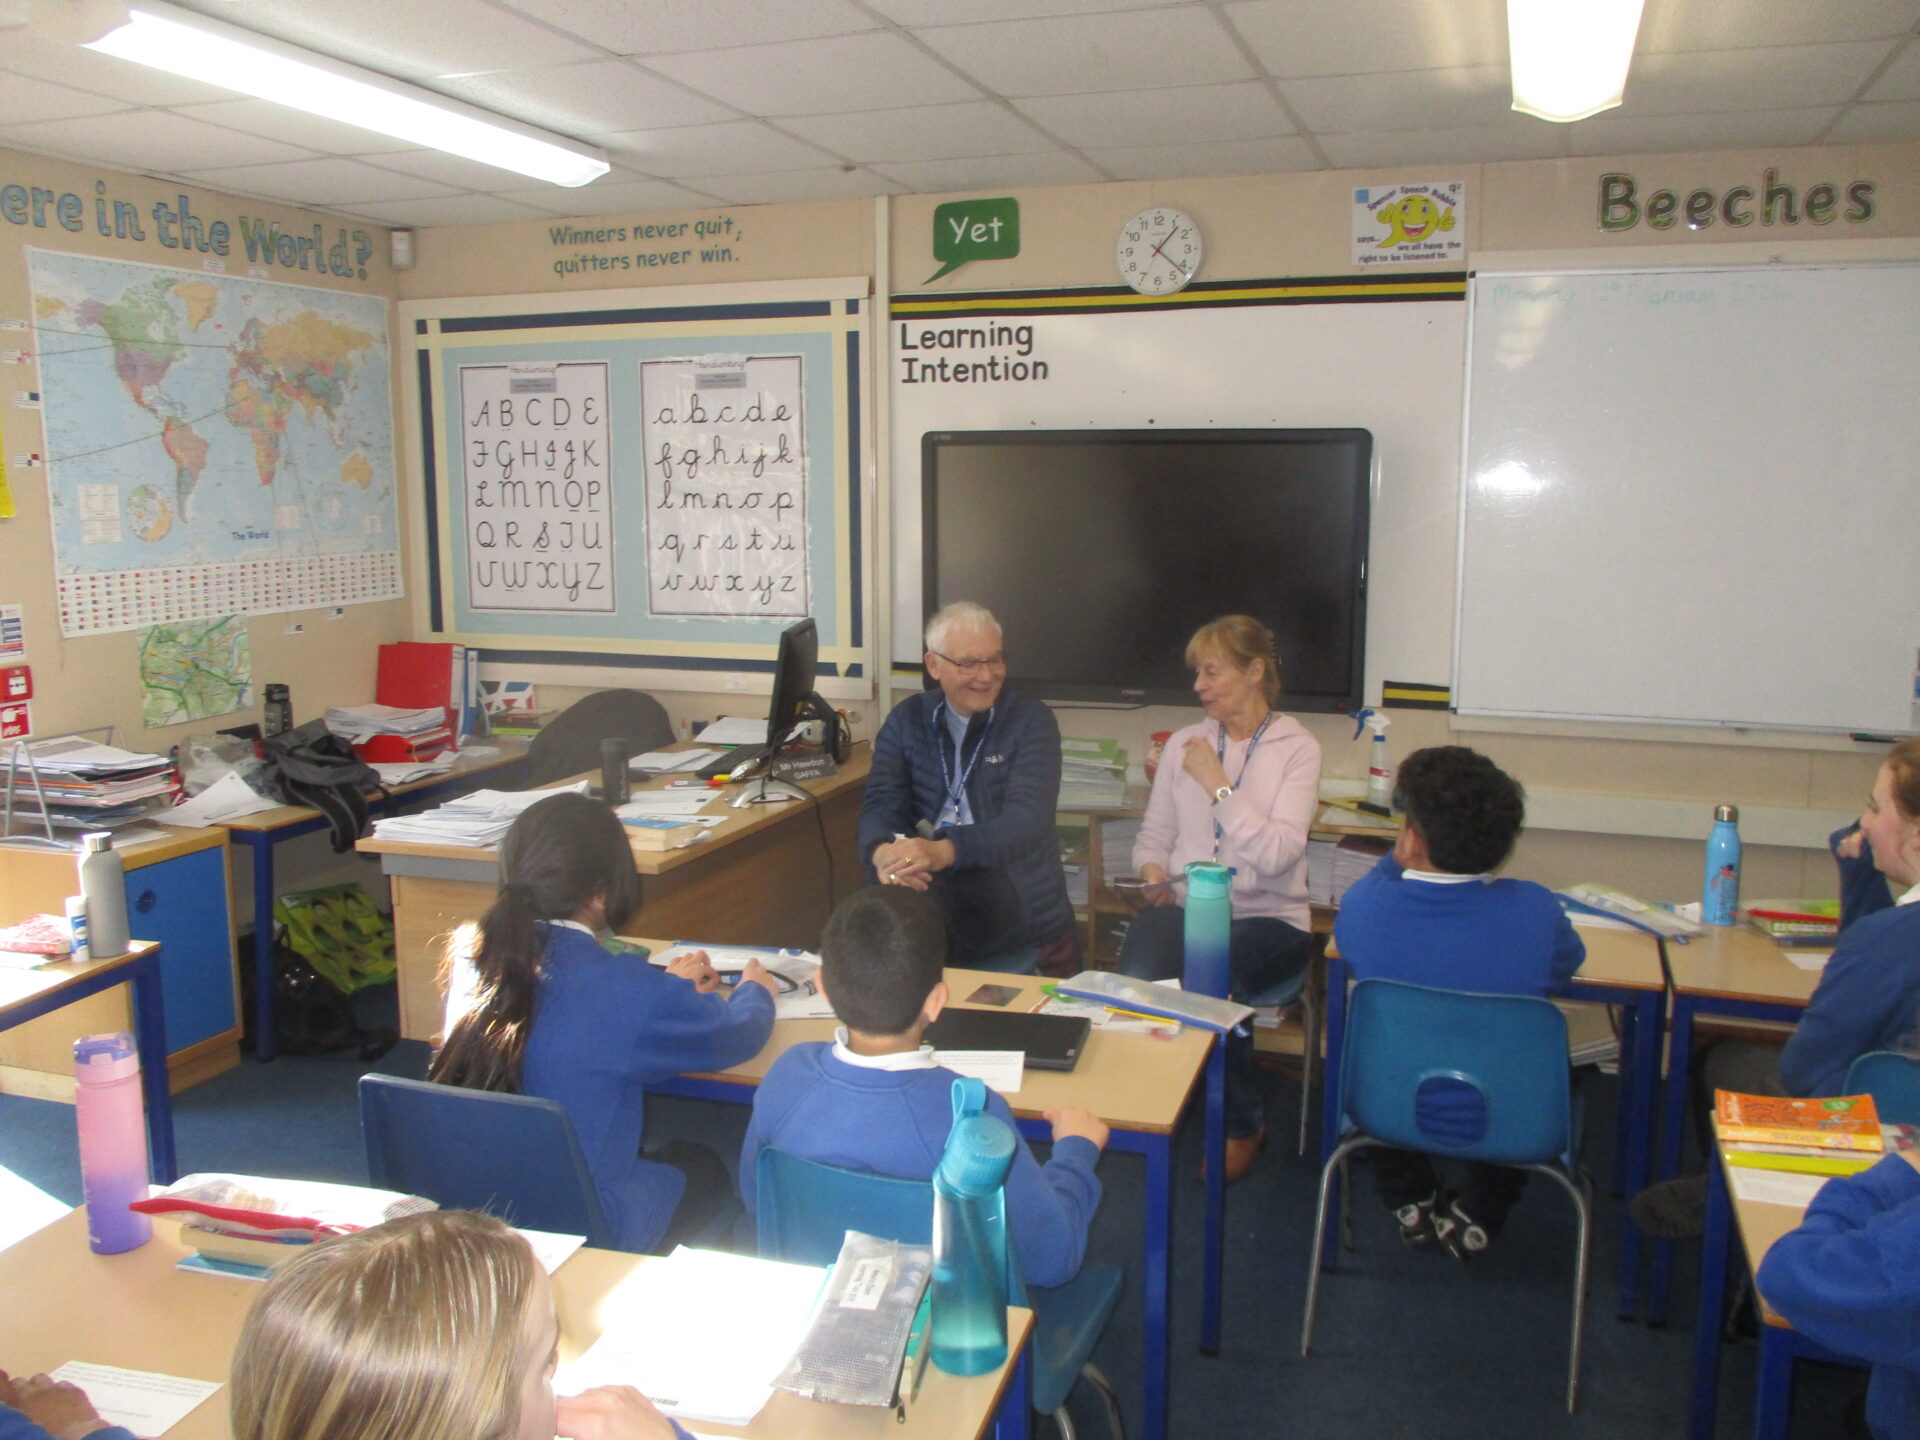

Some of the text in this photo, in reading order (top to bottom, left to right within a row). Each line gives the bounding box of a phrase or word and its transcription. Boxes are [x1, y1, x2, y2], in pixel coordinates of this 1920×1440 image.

[1598, 167, 1878, 233] Beeches
[1141, 221, 1148, 231] 11
[1155, 216, 1165, 226] 12
[95, 180, 145, 242] in
[152, 195, 231, 256] the
[238, 215, 373, 280] World?
[550, 224, 627, 246] Winners
[633, 222, 689, 240] never
[949, 216, 1004, 244] Yet
[1181, 230, 1189, 240] 2
[1129, 232, 1140, 242] 10
[1126, 247, 1134, 257] 9
[1184, 244, 1192, 255] 3
[554, 245, 740, 278] quitters never win.
[1129, 262, 1137, 272] 8
[1140, 272, 1147, 282] 7
[1154, 276, 1162, 286] 6
[1169, 271, 1177, 281] 5
[901, 321, 1033, 357] Learning
[901, 356, 1049, 384] Intention
[247, 530, 270, 540] World
